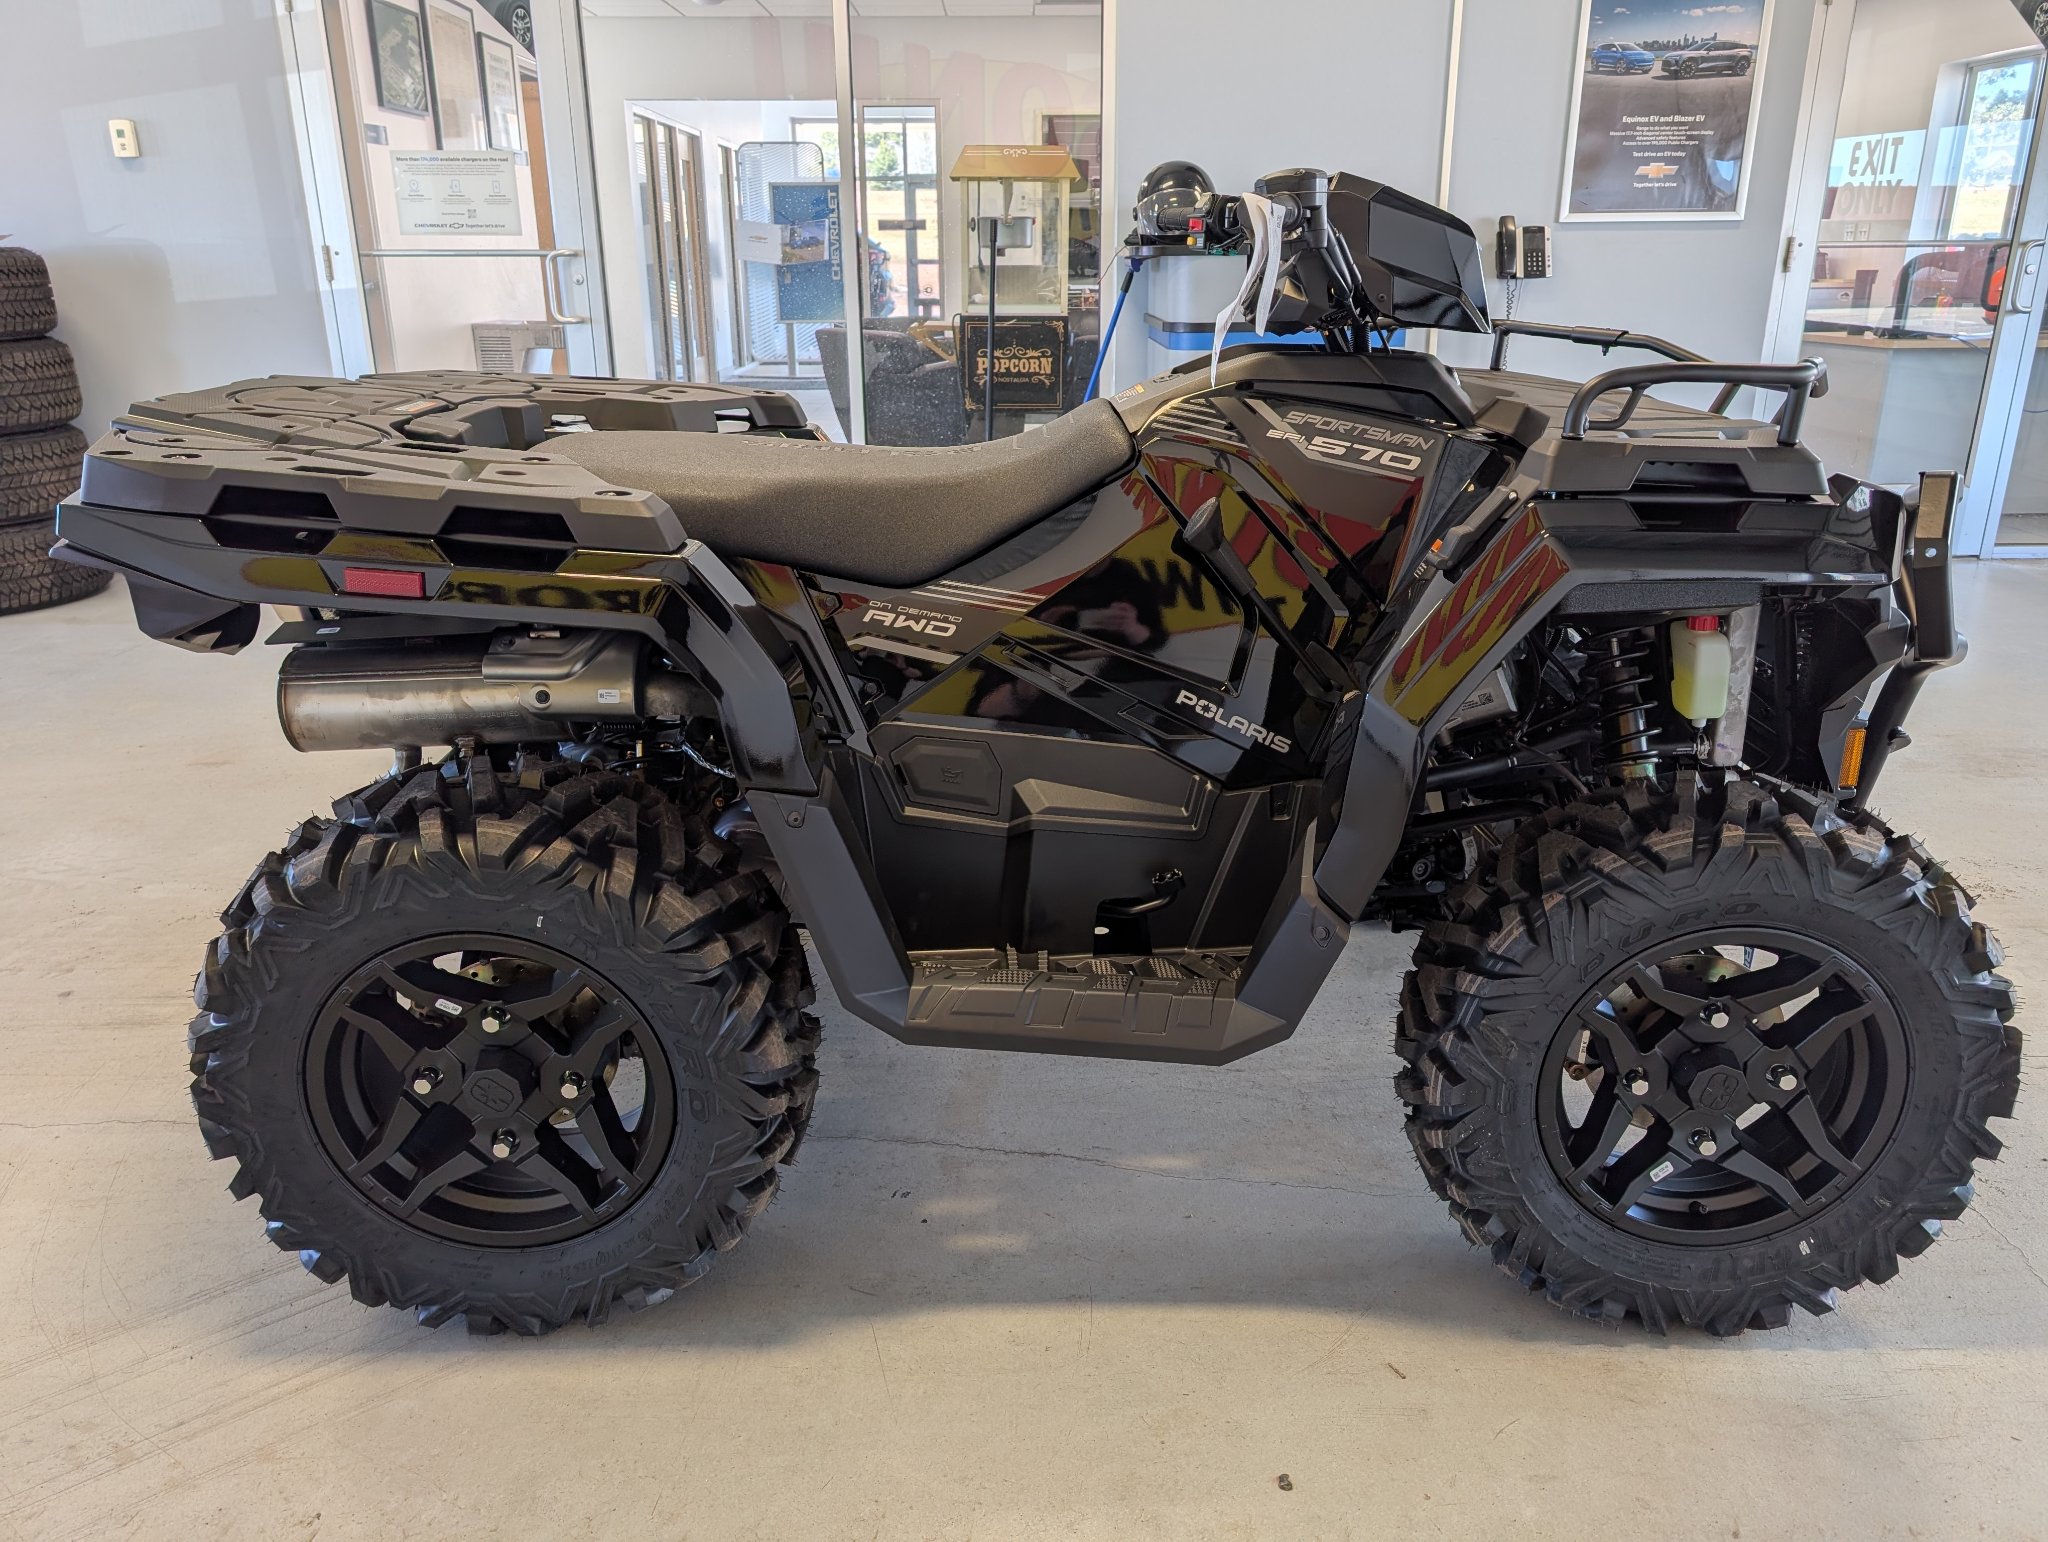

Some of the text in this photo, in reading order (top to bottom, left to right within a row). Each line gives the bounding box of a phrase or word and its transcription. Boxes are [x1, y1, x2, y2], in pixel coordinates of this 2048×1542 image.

[1848, 136, 1904, 177] EXIT
[1837, 179, 1903, 215] ONLY
[828, 189, 841, 281] CHEVROLET
[976, 358, 1052, 374] POPCORN
[1266, 429, 1422, 471] EFI 570
[1282, 410, 1436, 451] SPORTSMAN
[862, 609, 956, 637] AWD
[869, 600, 962, 623] ON DEMAND
[1175, 689, 1292, 754] POLARIS
